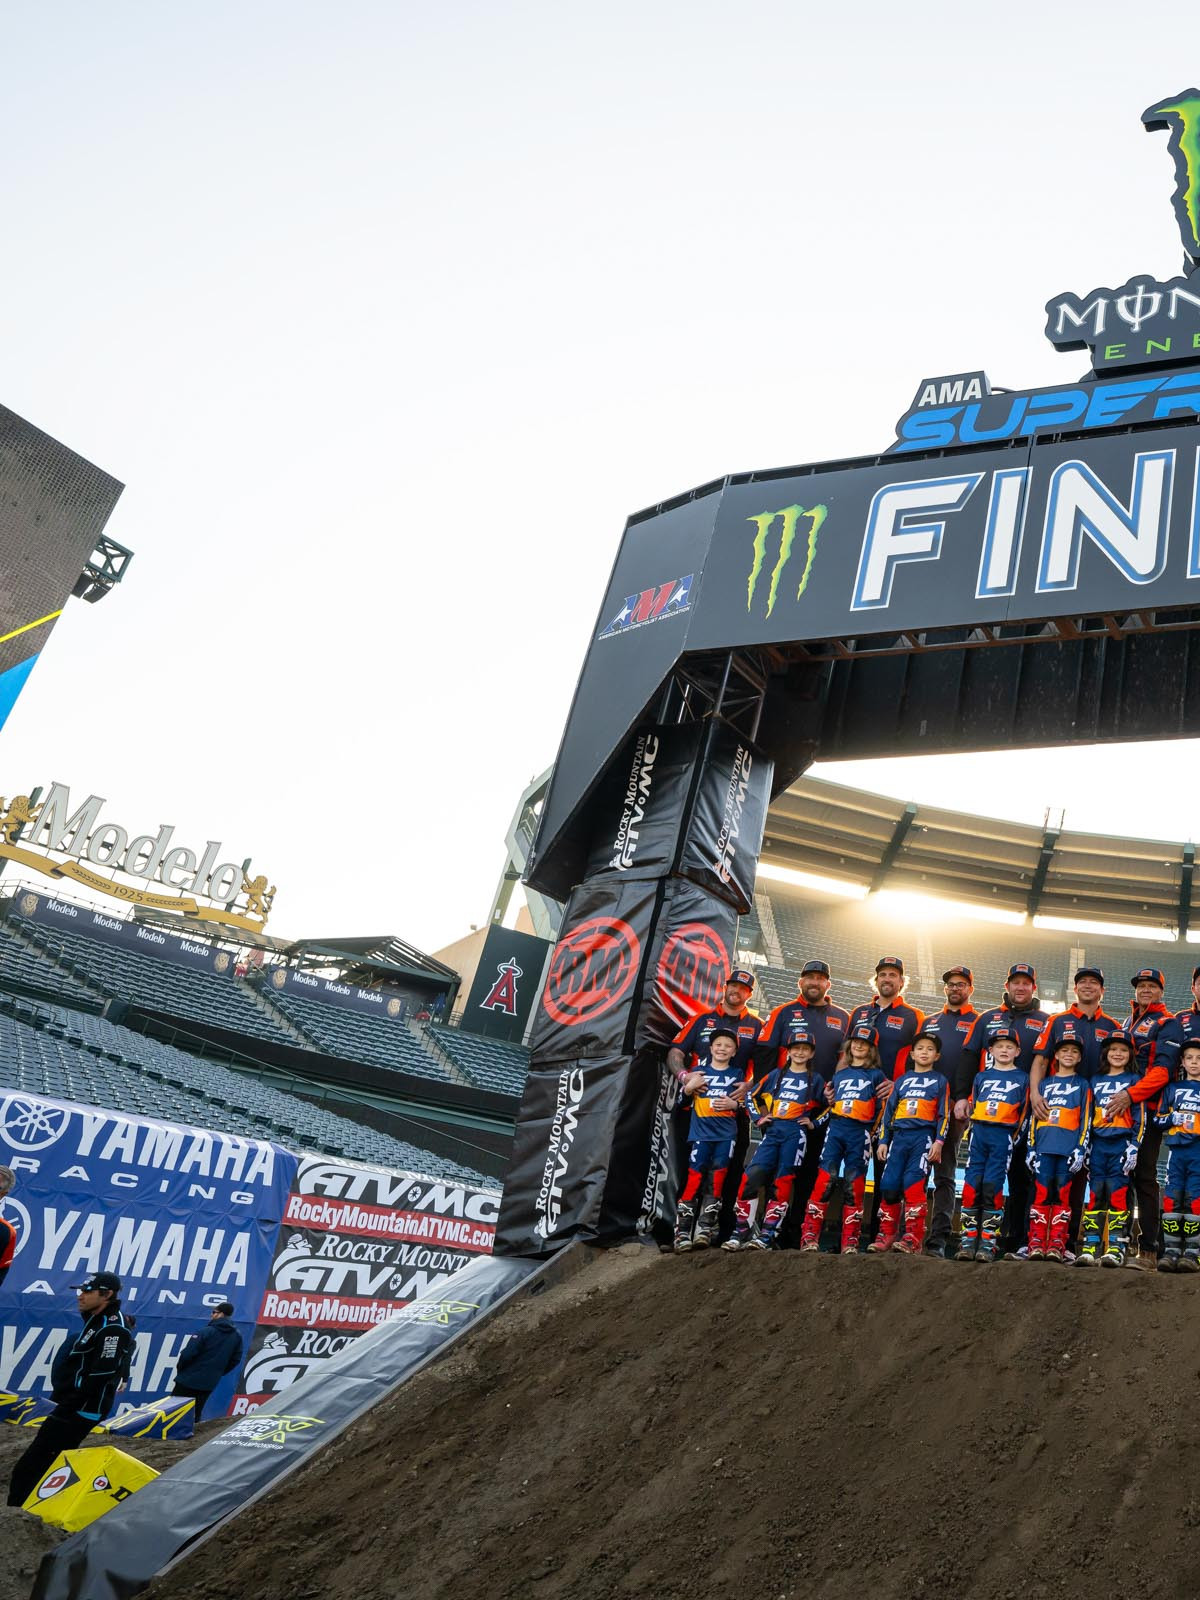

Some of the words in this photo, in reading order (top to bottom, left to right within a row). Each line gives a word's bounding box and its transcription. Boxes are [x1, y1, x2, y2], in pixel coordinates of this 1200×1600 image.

[918, 377, 982, 408] AMA
[598, 573, 694, 637] AMA
[725, 743, 745, 816] MOUNTAIN
[613, 808, 632, 851] ROCKY
[624, 735, 646, 807] MOUNTAIN
[26, 781, 245, 904] Modelo
[113, 885, 144, 902] 1925
[46, 900, 78, 918] Modelo
[93, 914, 123, 932] Modelo
[136, 928, 166, 946] Modelo
[180, 941, 210, 957] Modelo
[293, 972, 318, 987] Modelo
[325, 981, 350, 996] Modelo
[480, 957, 523, 1017] A
[357, 989, 383, 1003] Modelo
[780, 1077, 808, 1091] FLY
[838, 1078, 872, 1094] FLY
[899, 1077, 938, 1091] FLY
[980, 1079, 1021, 1094] FLY
[1043, 1082, 1080, 1098] FLY
[1093, 1081, 1130, 1094] FLY
[779, 1092, 800, 1101] KTM
[841, 1090, 861, 1099] KTM
[905, 1089, 926, 1098] KTM
[986, 1092, 1008, 1101] KTM
[1048, 1097, 1067, 1106] KTM
[76, 1113, 275, 1187] YAMAHA
[535, 1157, 555, 1212] ROCKY
[548, 1070, 570, 1154] MOUNTAIN
[641, 1158, 659, 1213] ROCKY
[651, 1073, 669, 1156] MOUNTAIN
[9, 1155, 255, 1205] RACING
[38, 1207, 250, 1287] YAMAHA
[316, 1234, 394, 1267] ROCKY
[393, 1248, 474, 1272] MOUNT
[22, 1280, 228, 1307] AING
[0, 1325, 193, 1392] YAAH
